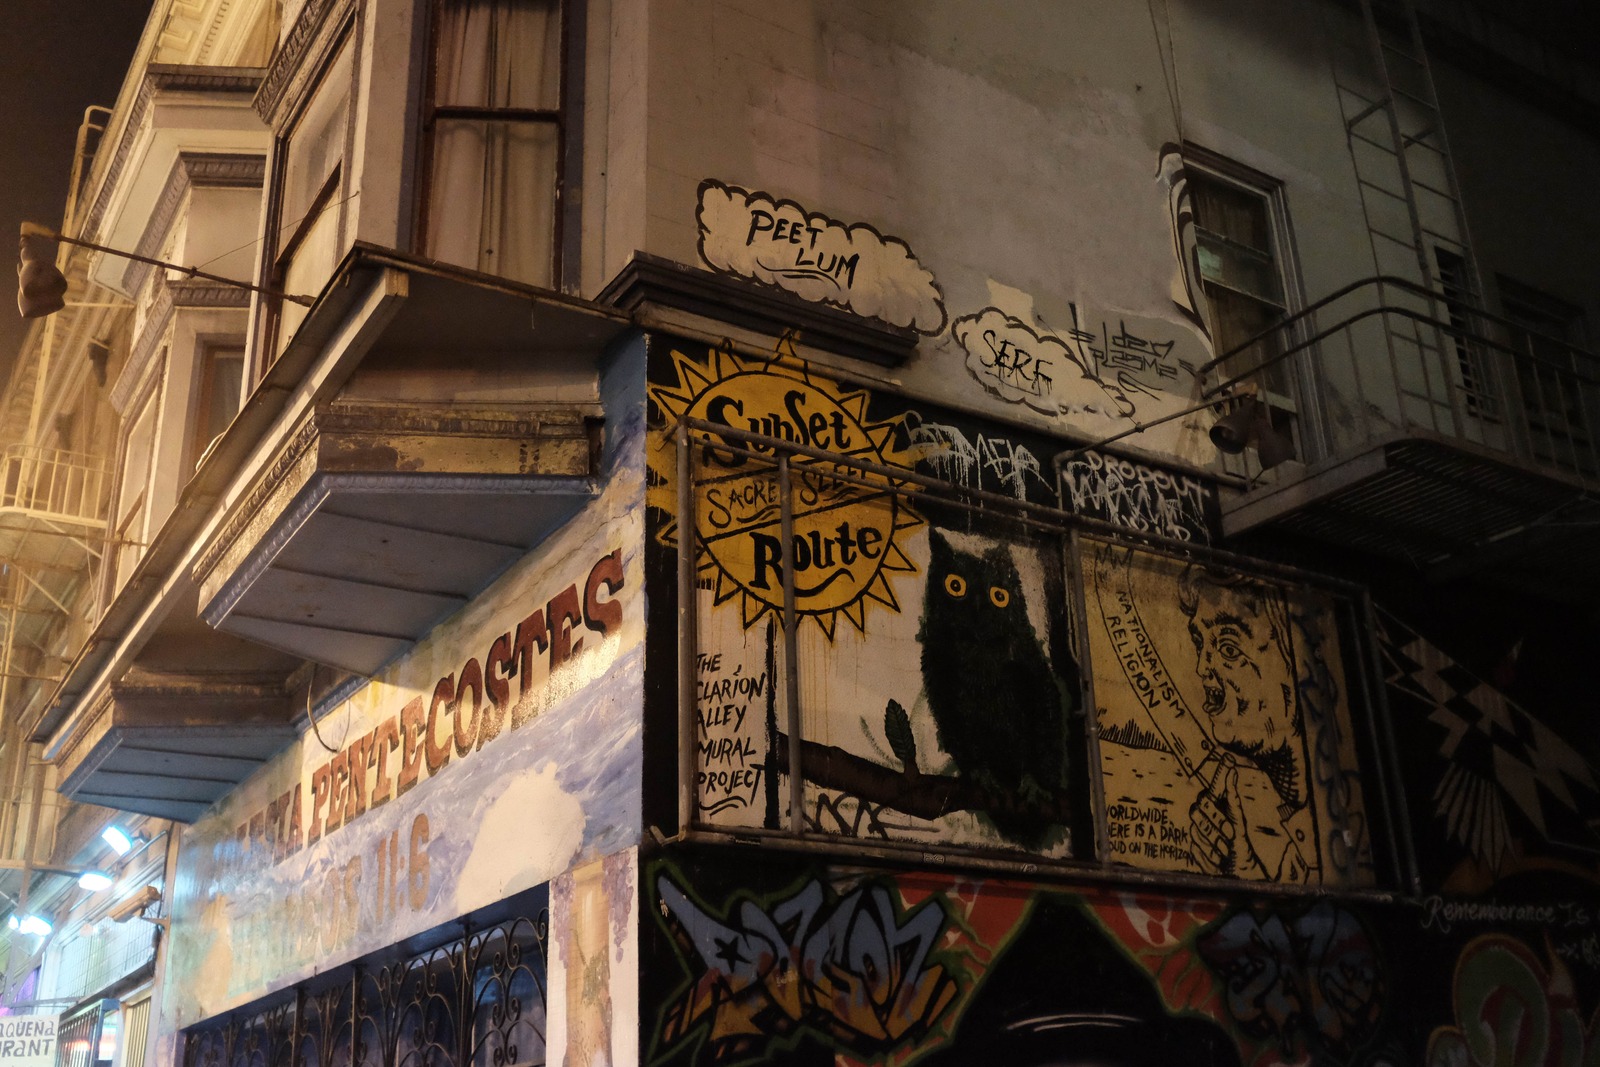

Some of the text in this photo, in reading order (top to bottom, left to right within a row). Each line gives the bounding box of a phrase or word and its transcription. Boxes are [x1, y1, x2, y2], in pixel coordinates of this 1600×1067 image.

[746, 210, 824, 250] PEET
[795, 247, 860, 290] LUM
[706, 477, 793, 529] SACRE
[697, 653, 722, 674] THE
[1106, 615, 1161, 709] RELIGION
[1116, 590, 1186, 719] NATIONALISM
[308, 547, 625, 849] PENTECOSTES
[697, 736, 757, 767] MURAL
[698, 763, 766, 806] PROJECT
[1107, 821, 1188, 846] ERE IS A DARK
[1129, 842, 1142, 854] ON
[1144, 842, 1158, 859] THE
